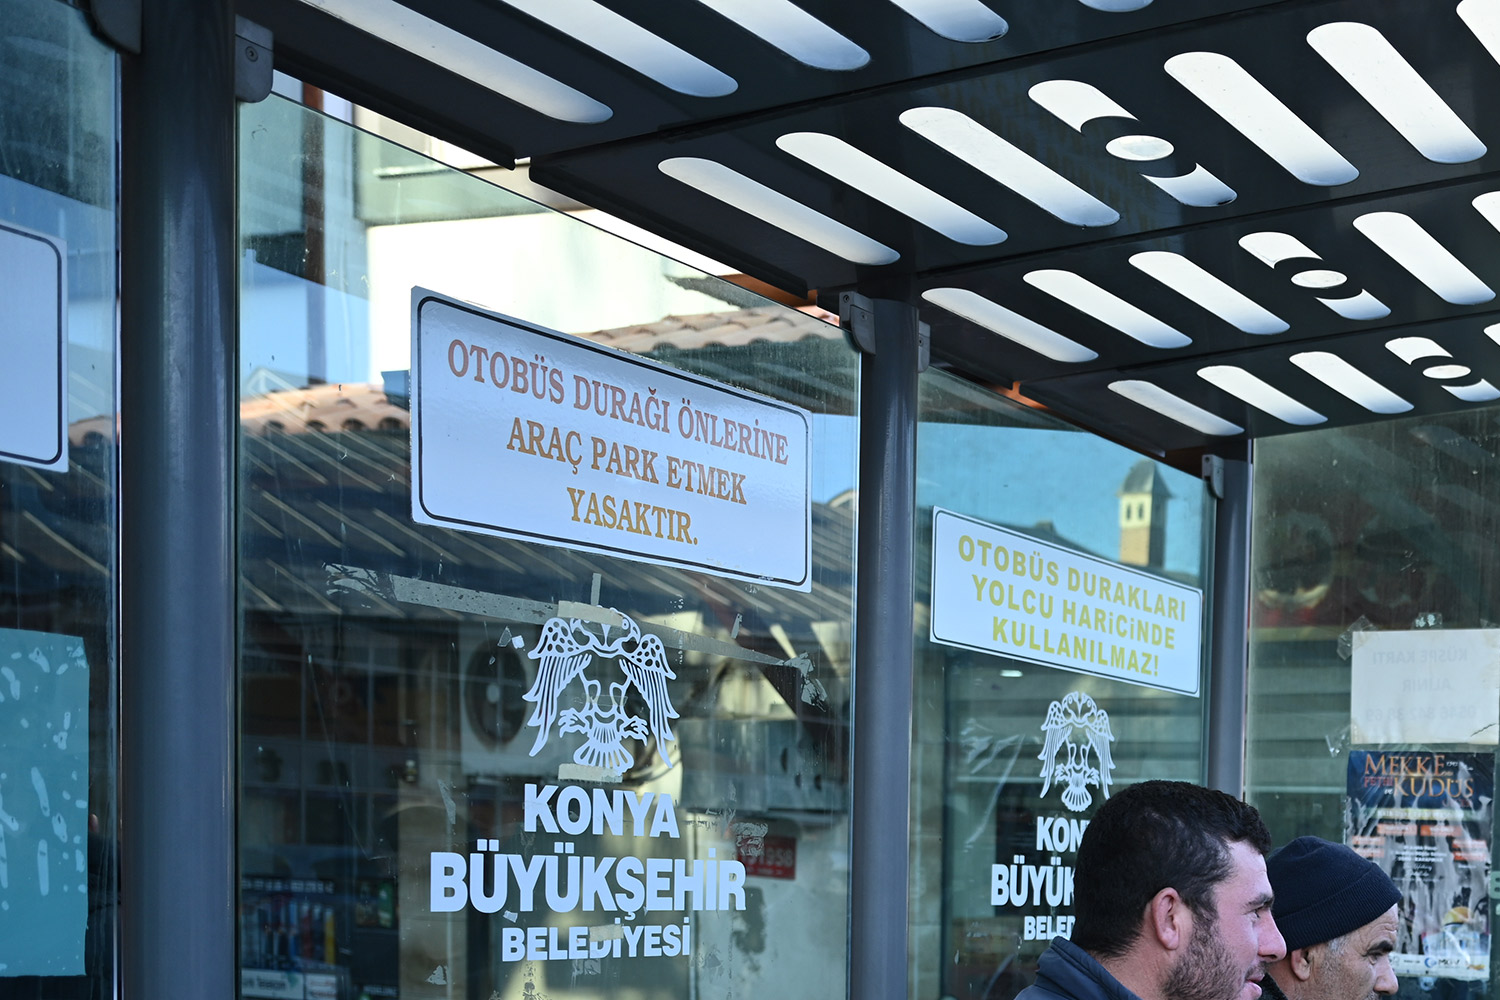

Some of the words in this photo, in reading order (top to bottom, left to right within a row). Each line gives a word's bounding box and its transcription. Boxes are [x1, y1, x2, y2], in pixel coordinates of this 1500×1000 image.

[448, 338, 565, 405] OTOBÜS
[573, 374, 671, 434] DURAĞI
[678, 398, 789, 465] ÖNLERİNE
[506, 416, 583, 475] ARAÇ
[590, 435, 659, 485] PARK
[666, 457, 747, 505] ETMEK
[566, 487, 698, 546] YASAKTIR.
[958, 534, 1059, 586] OTOBÜS
[1068, 567, 1186, 622] DURAKLARI
[971, 574, 1054, 619] YOLCU
[992, 615, 1159, 677] KULLANILMAZ!
[1365, 753, 1445, 776] MEKKE
[1393, 777, 1474, 798] KUDÜS
[524, 783, 680, 838] KONYA
[1036, 816, 1090, 853] KON
[430, 839, 746, 920] BÜYÜKŞEHİR
[991, 855, 1075, 906] BÜYÜK
[502, 917, 690, 962] BELEDİYESİ
